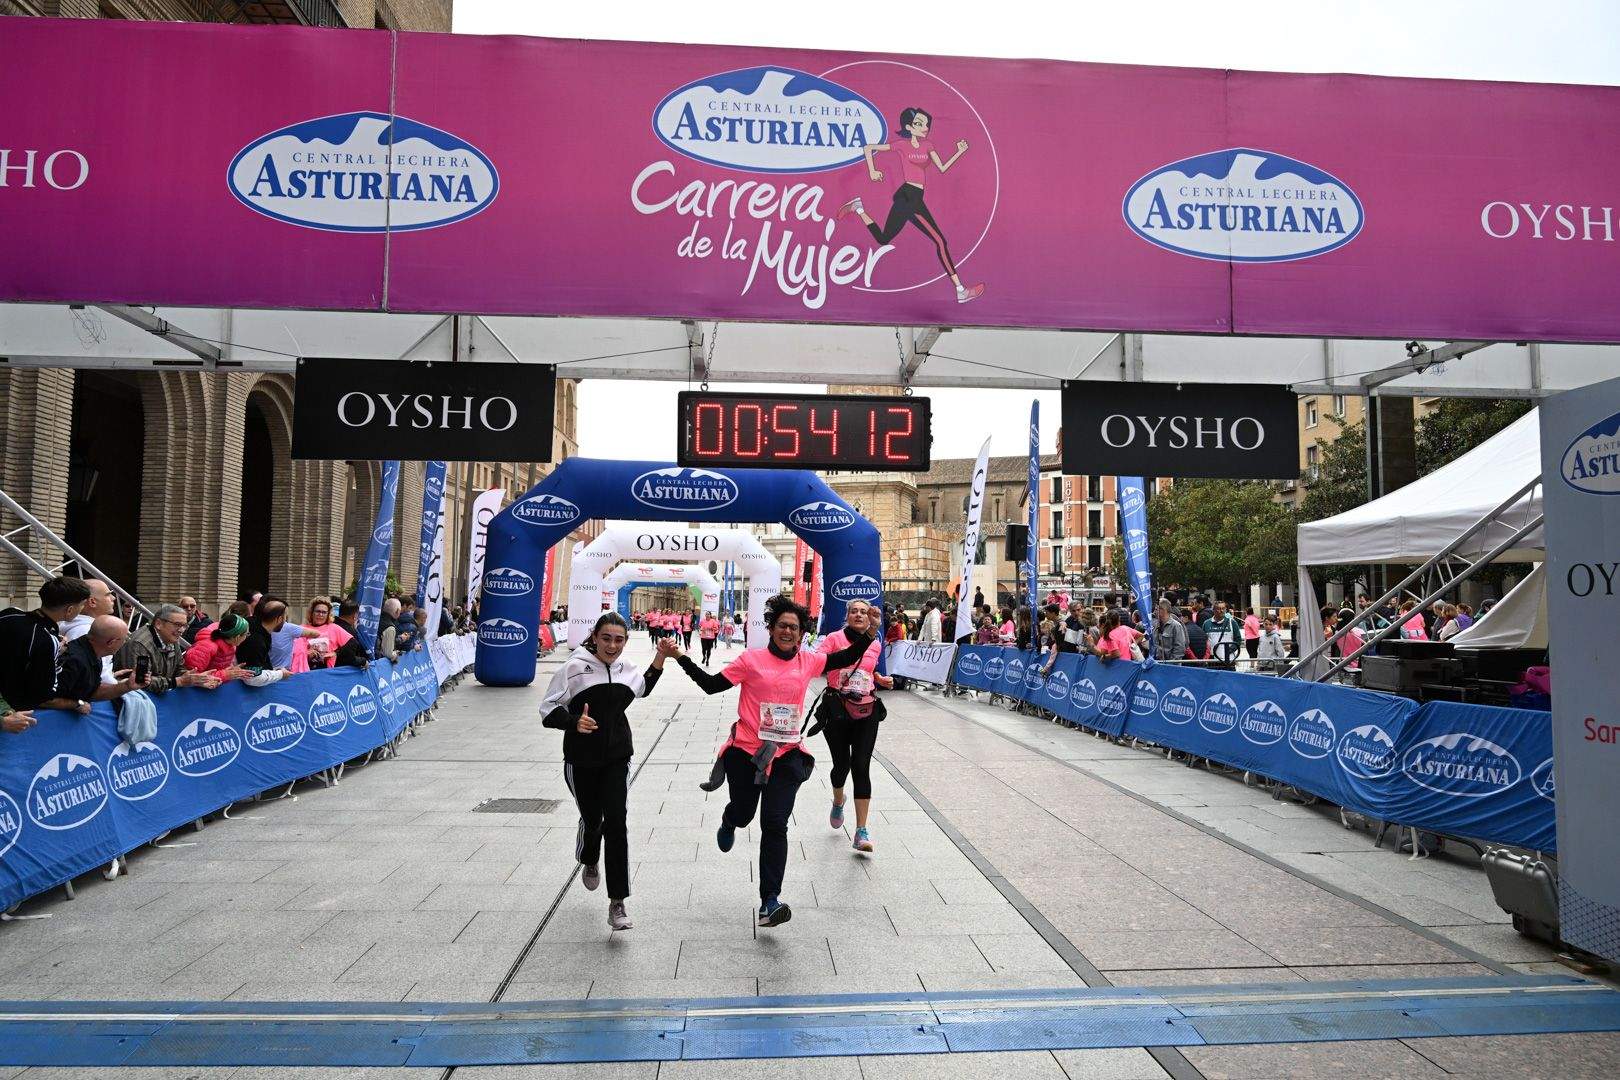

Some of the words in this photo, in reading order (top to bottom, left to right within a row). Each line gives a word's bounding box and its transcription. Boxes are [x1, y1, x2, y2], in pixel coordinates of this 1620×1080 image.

[708, 100, 781, 114] CENTRAL
[789, 104, 863, 117] LECHERA
[671, 101, 869, 149] ASTURIANA
[292, 151, 376, 165] CENTRAL
[386, 154, 470, 168] LECHERA
[248, 153, 478, 204] ASTURIANA
[630, 160, 824, 222] Carrera
[1179, 185, 1254, 199] CENTRAL
[1262, 187, 1337, 201] LECHERA
[1142, 187, 1346, 235] ASTURIANA
[1480, 201, 1620, 241] OYSH
[677, 222, 714, 258] de
[722, 221, 748, 261] la
[741, 218, 896, 309] Mujer
[337, 391, 518, 432] OYSHO
[1101, 414, 1265, 450] OYSHO
[640, 479, 731, 501] ASTURIANA
[516, 504, 574, 519] ASTURIANA
[795, 513, 851, 525] ASTURIANA
[636, 534, 720, 552] OYSHO
[741, 552, 767, 560] OYSHO
[485, 577, 530, 590] ASTURIANA
[835, 585, 880, 596] ASTURIANA
[1567, 562, 1620, 597] OY
[479, 627, 524, 641] ASTURIANA
[903, 644, 943, 664] OYSHO
[314, 710, 346, 729] ASTURIANA
[1161, 698, 1193, 718] ASTURIANA
[1200, 704, 1234, 727] ASTURIANA
[251, 721, 303, 746] ASTURIANA
[1242, 713, 1283, 737] ASTURIANA
[178, 738, 238, 769] ASTURIANA
[112, 760, 167, 791] ASTURIANA
[1408, 751, 1510, 786] ASTURIANA
[35, 779, 106, 821] ASTURIANA
